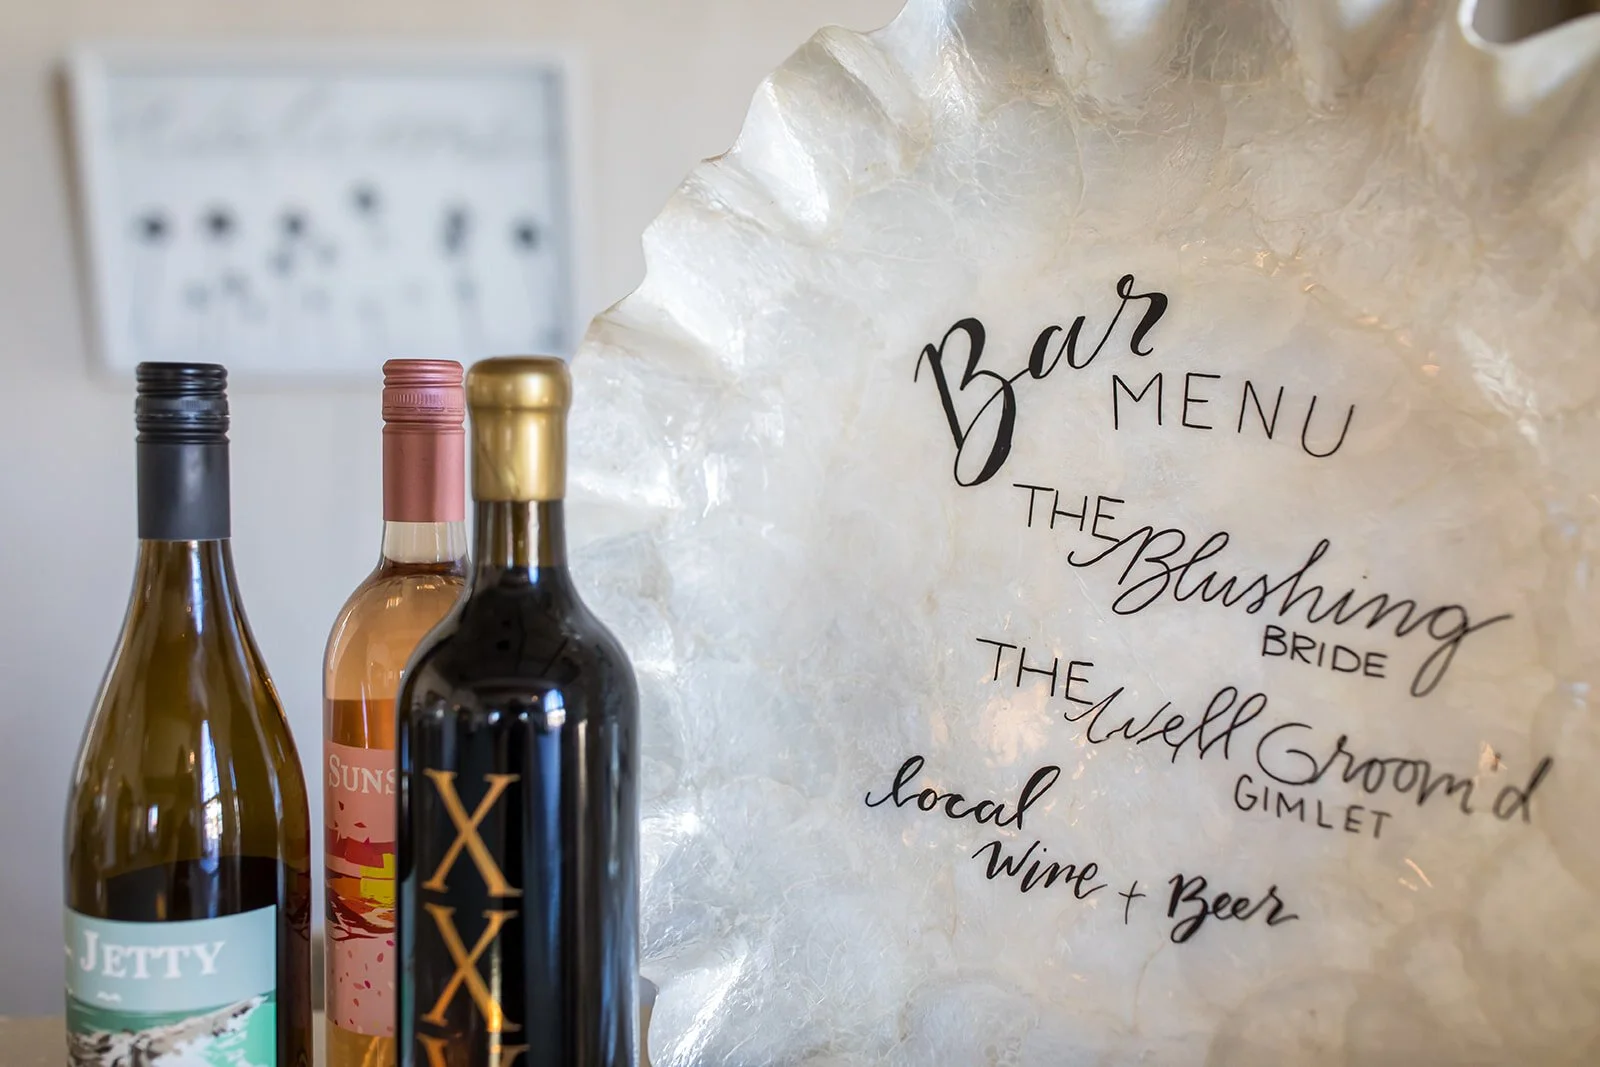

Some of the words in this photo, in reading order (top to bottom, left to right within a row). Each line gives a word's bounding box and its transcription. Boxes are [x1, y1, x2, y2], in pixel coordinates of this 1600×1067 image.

[914, 273, 1168, 487] Bar
[1112, 371, 1356, 458] MENU
[1012, 483, 1125, 543] THE
[1067, 525, 1512, 698] Blushing
[1261, 625, 1389, 679] BRIDE
[976, 637, 1094, 706] THE
[1255, 721, 1554, 825] Groom'd
[1234, 773, 1393, 839] GIMLET
[1117, 879, 1147, 925] +
[1166, 872, 1299, 944] Beer
